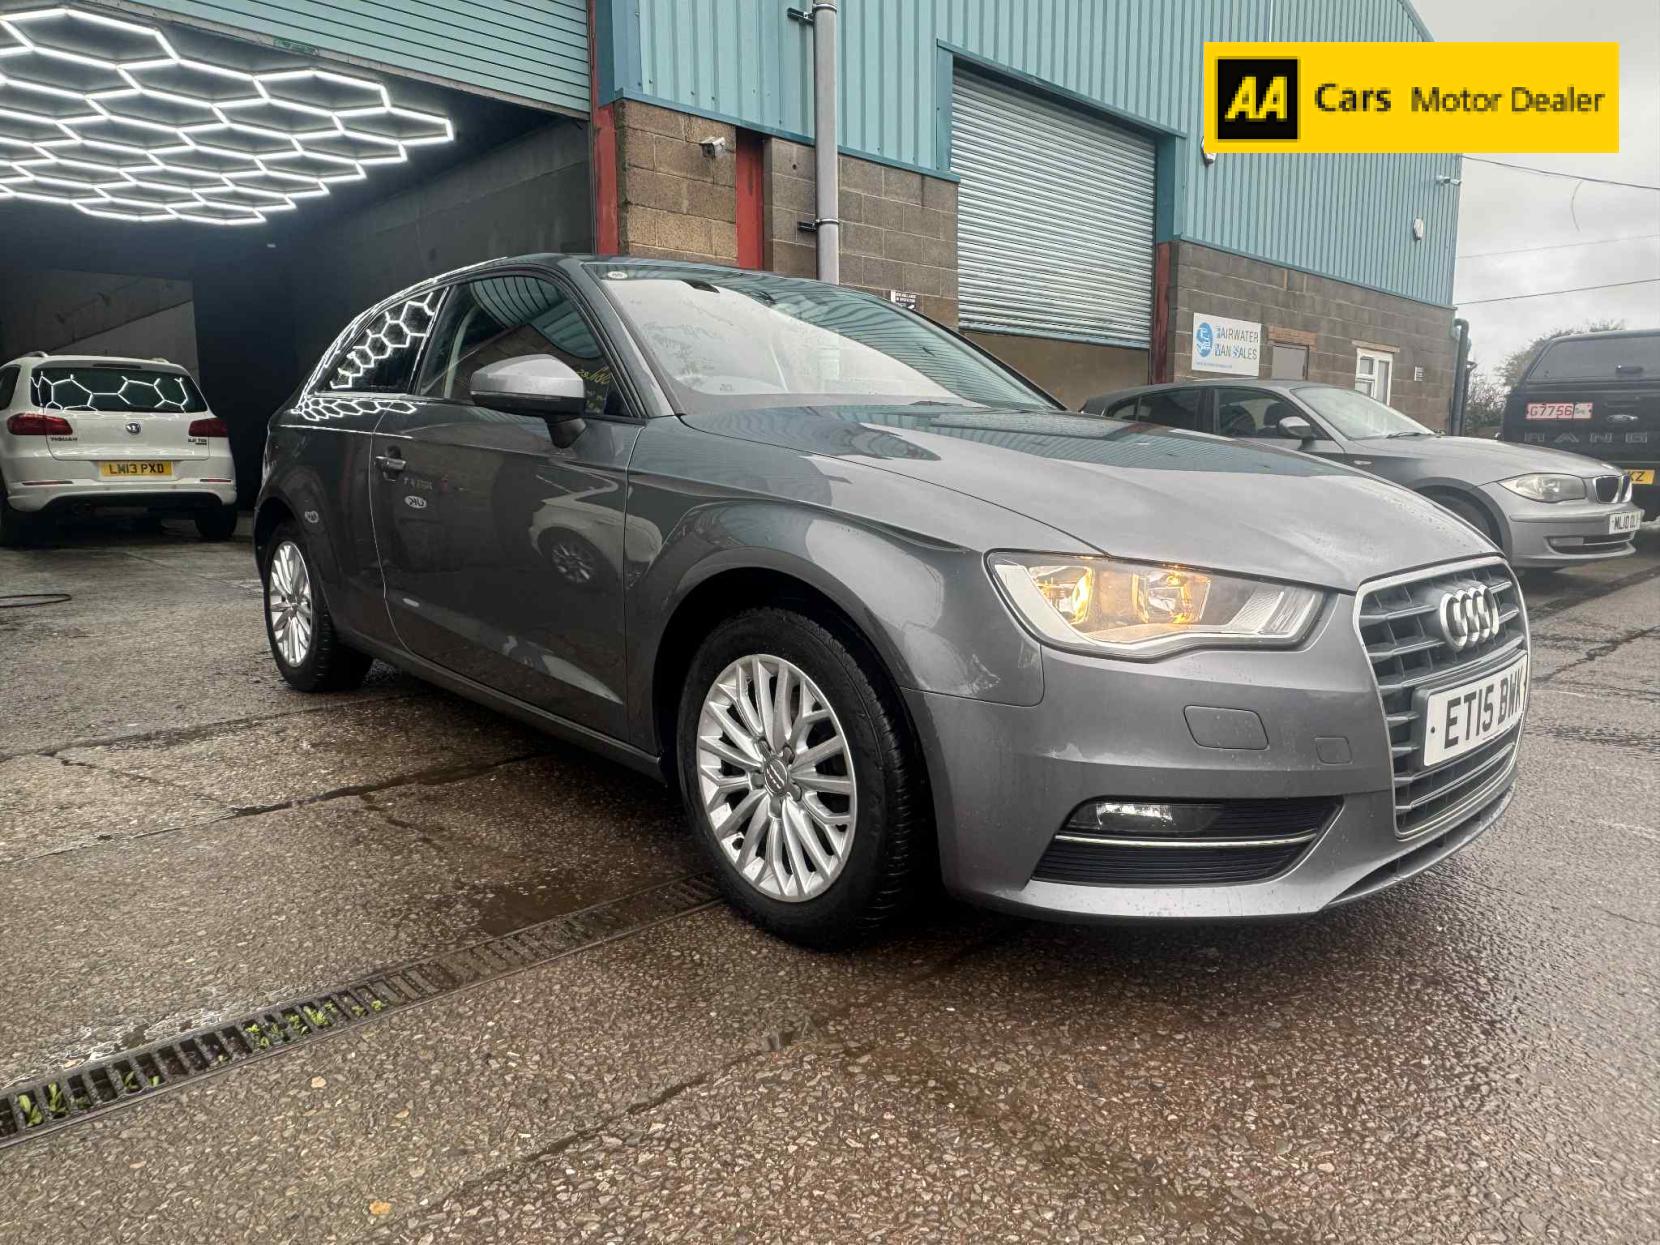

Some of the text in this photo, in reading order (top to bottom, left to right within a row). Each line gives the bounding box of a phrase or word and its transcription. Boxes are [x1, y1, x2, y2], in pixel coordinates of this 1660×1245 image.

[1232, 345, 1258, 361] SALES
[141, 462, 165, 474] PXD
[1444, 683, 1494, 749] ET15
